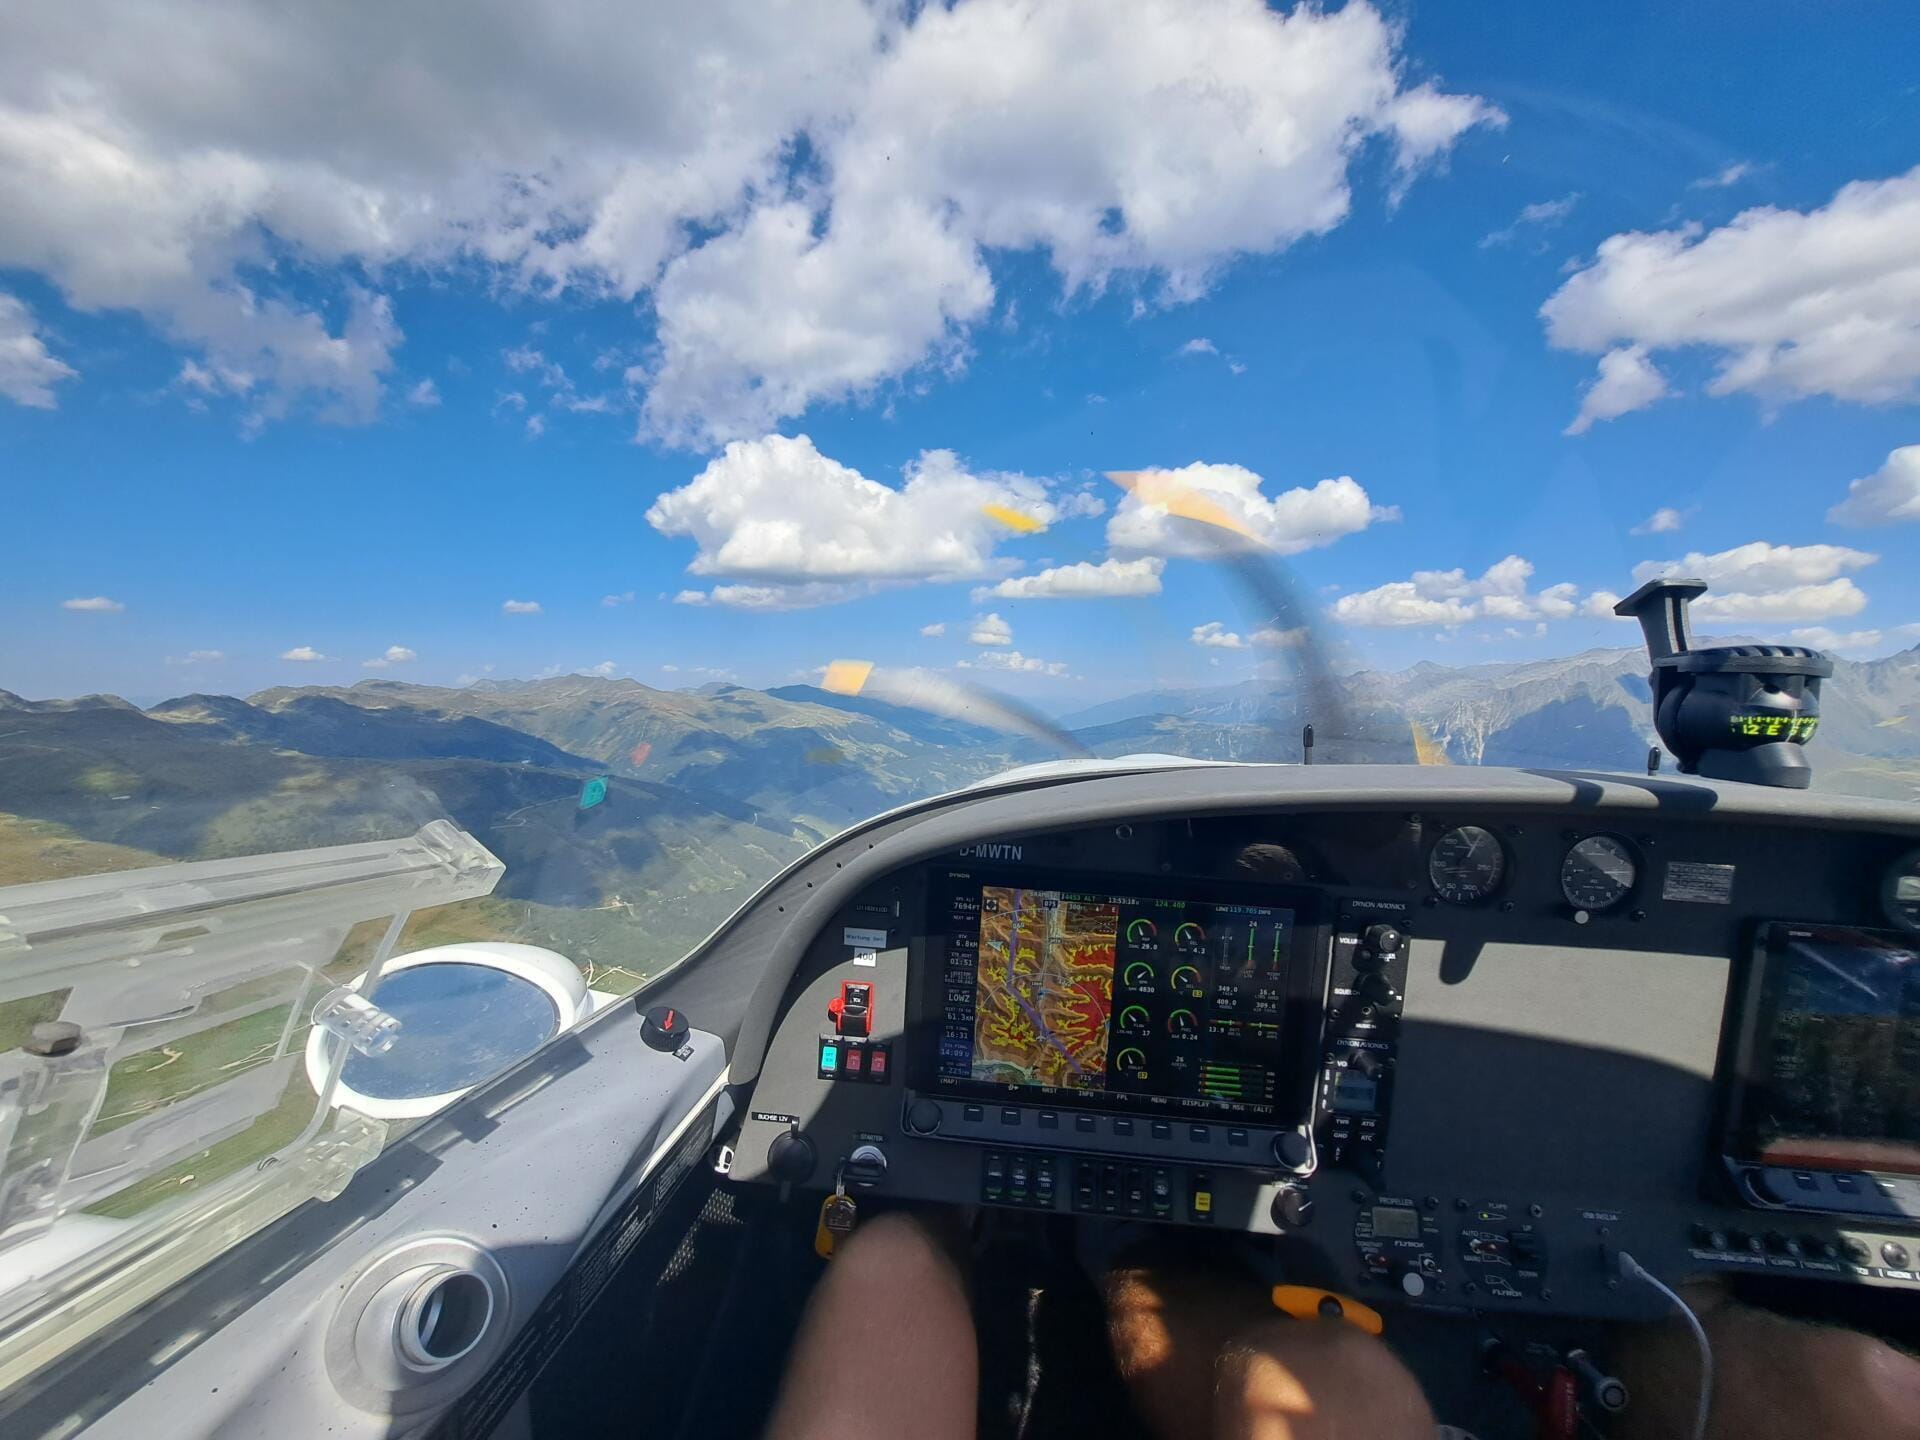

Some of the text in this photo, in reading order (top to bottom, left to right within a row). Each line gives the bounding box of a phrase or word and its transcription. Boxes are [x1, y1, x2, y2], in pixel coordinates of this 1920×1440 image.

[1743, 724, 1760, 735] 12
[1766, 724, 1780, 735] E
[960, 844, 1022, 860] D-MWTN
[948, 993, 970, 1002] LOWZ
[1181, 1099, 1210, 1107] DISPLAY
[1462, 1229, 1479, 1237] AUTO
[1394, 1240, 1425, 1248] FLYBOX
